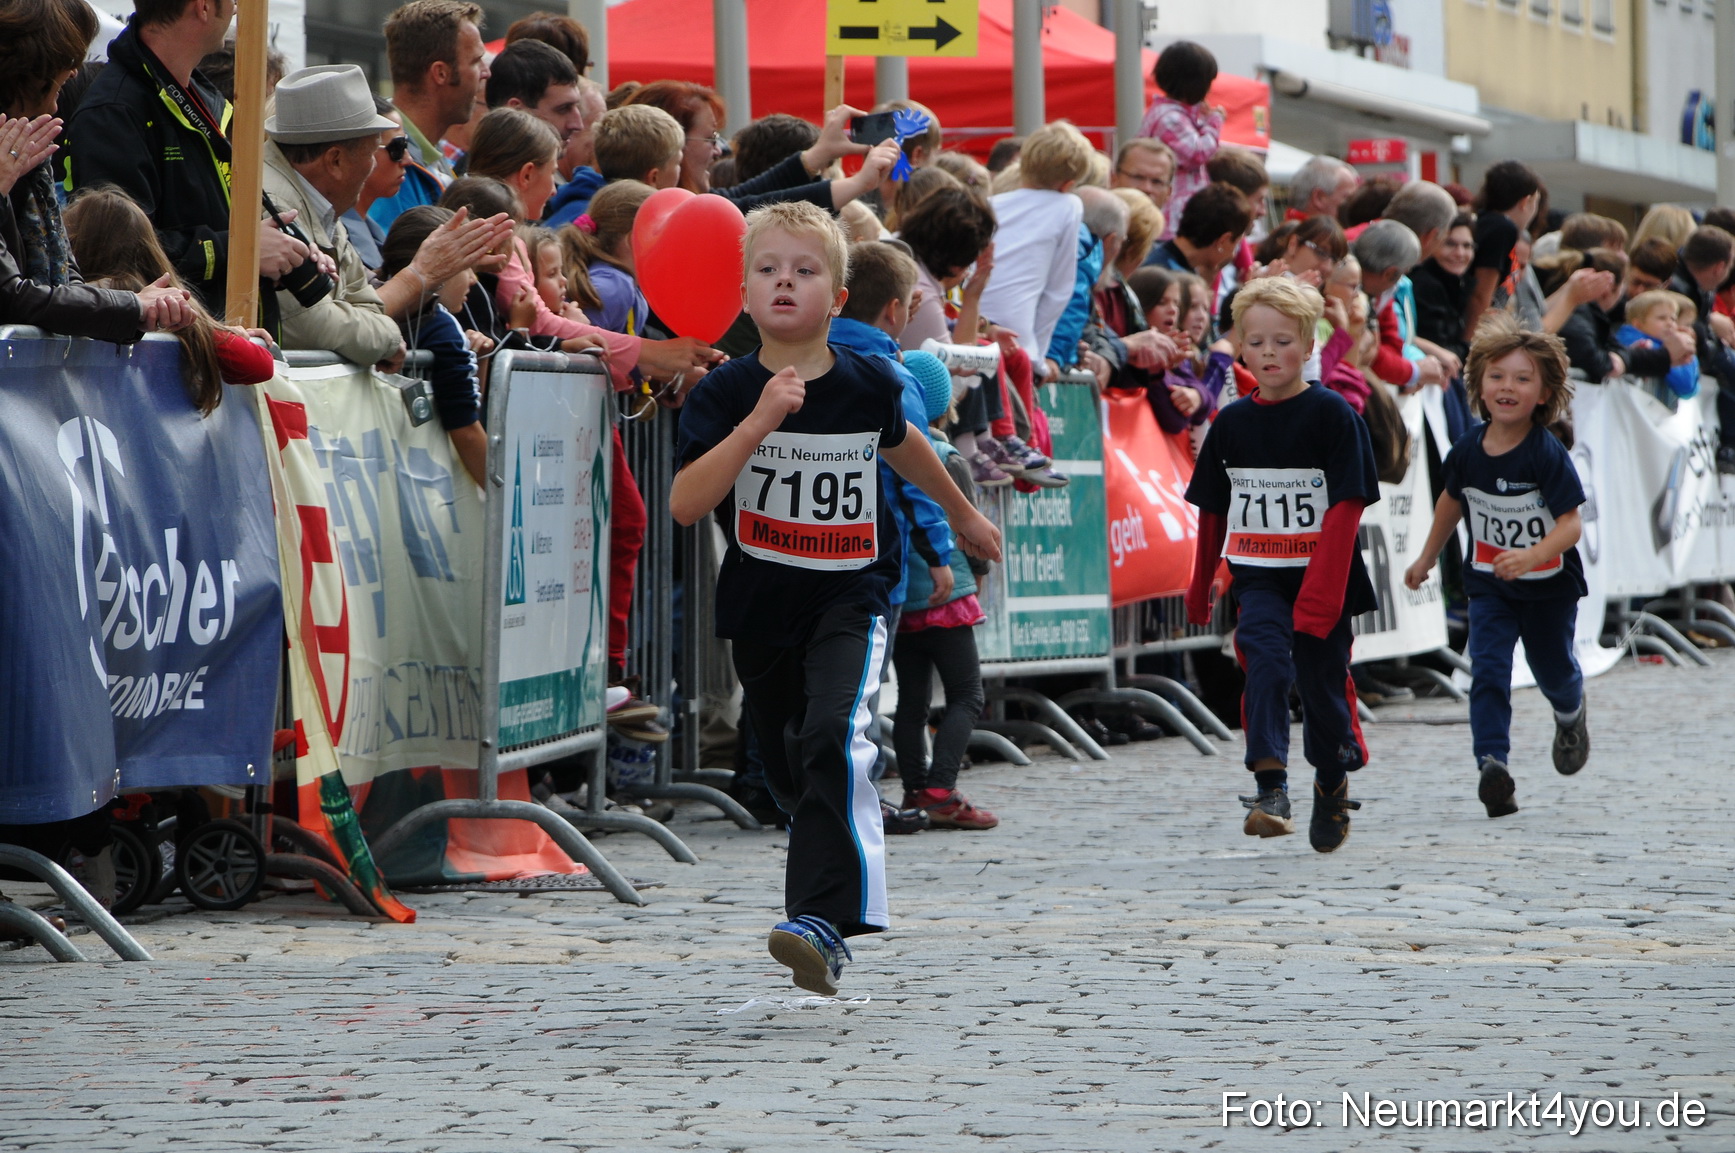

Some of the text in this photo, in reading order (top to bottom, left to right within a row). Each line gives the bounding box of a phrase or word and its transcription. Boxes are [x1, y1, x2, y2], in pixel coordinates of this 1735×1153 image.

[183, 104, 211, 138] DIGITAL
[753, 445, 859, 462] RTL Neumarkt
[751, 465, 863, 521] 7195
[1232, 478, 1307, 488] PARTL Neumarkt
[1238, 493, 1315, 528] 7115
[1491, 503, 1536, 513] Neumarkt
[752, 520, 861, 553] Maximilian
[1110, 503, 1148, 567] geht
[1477, 511, 1546, 549] 7329
